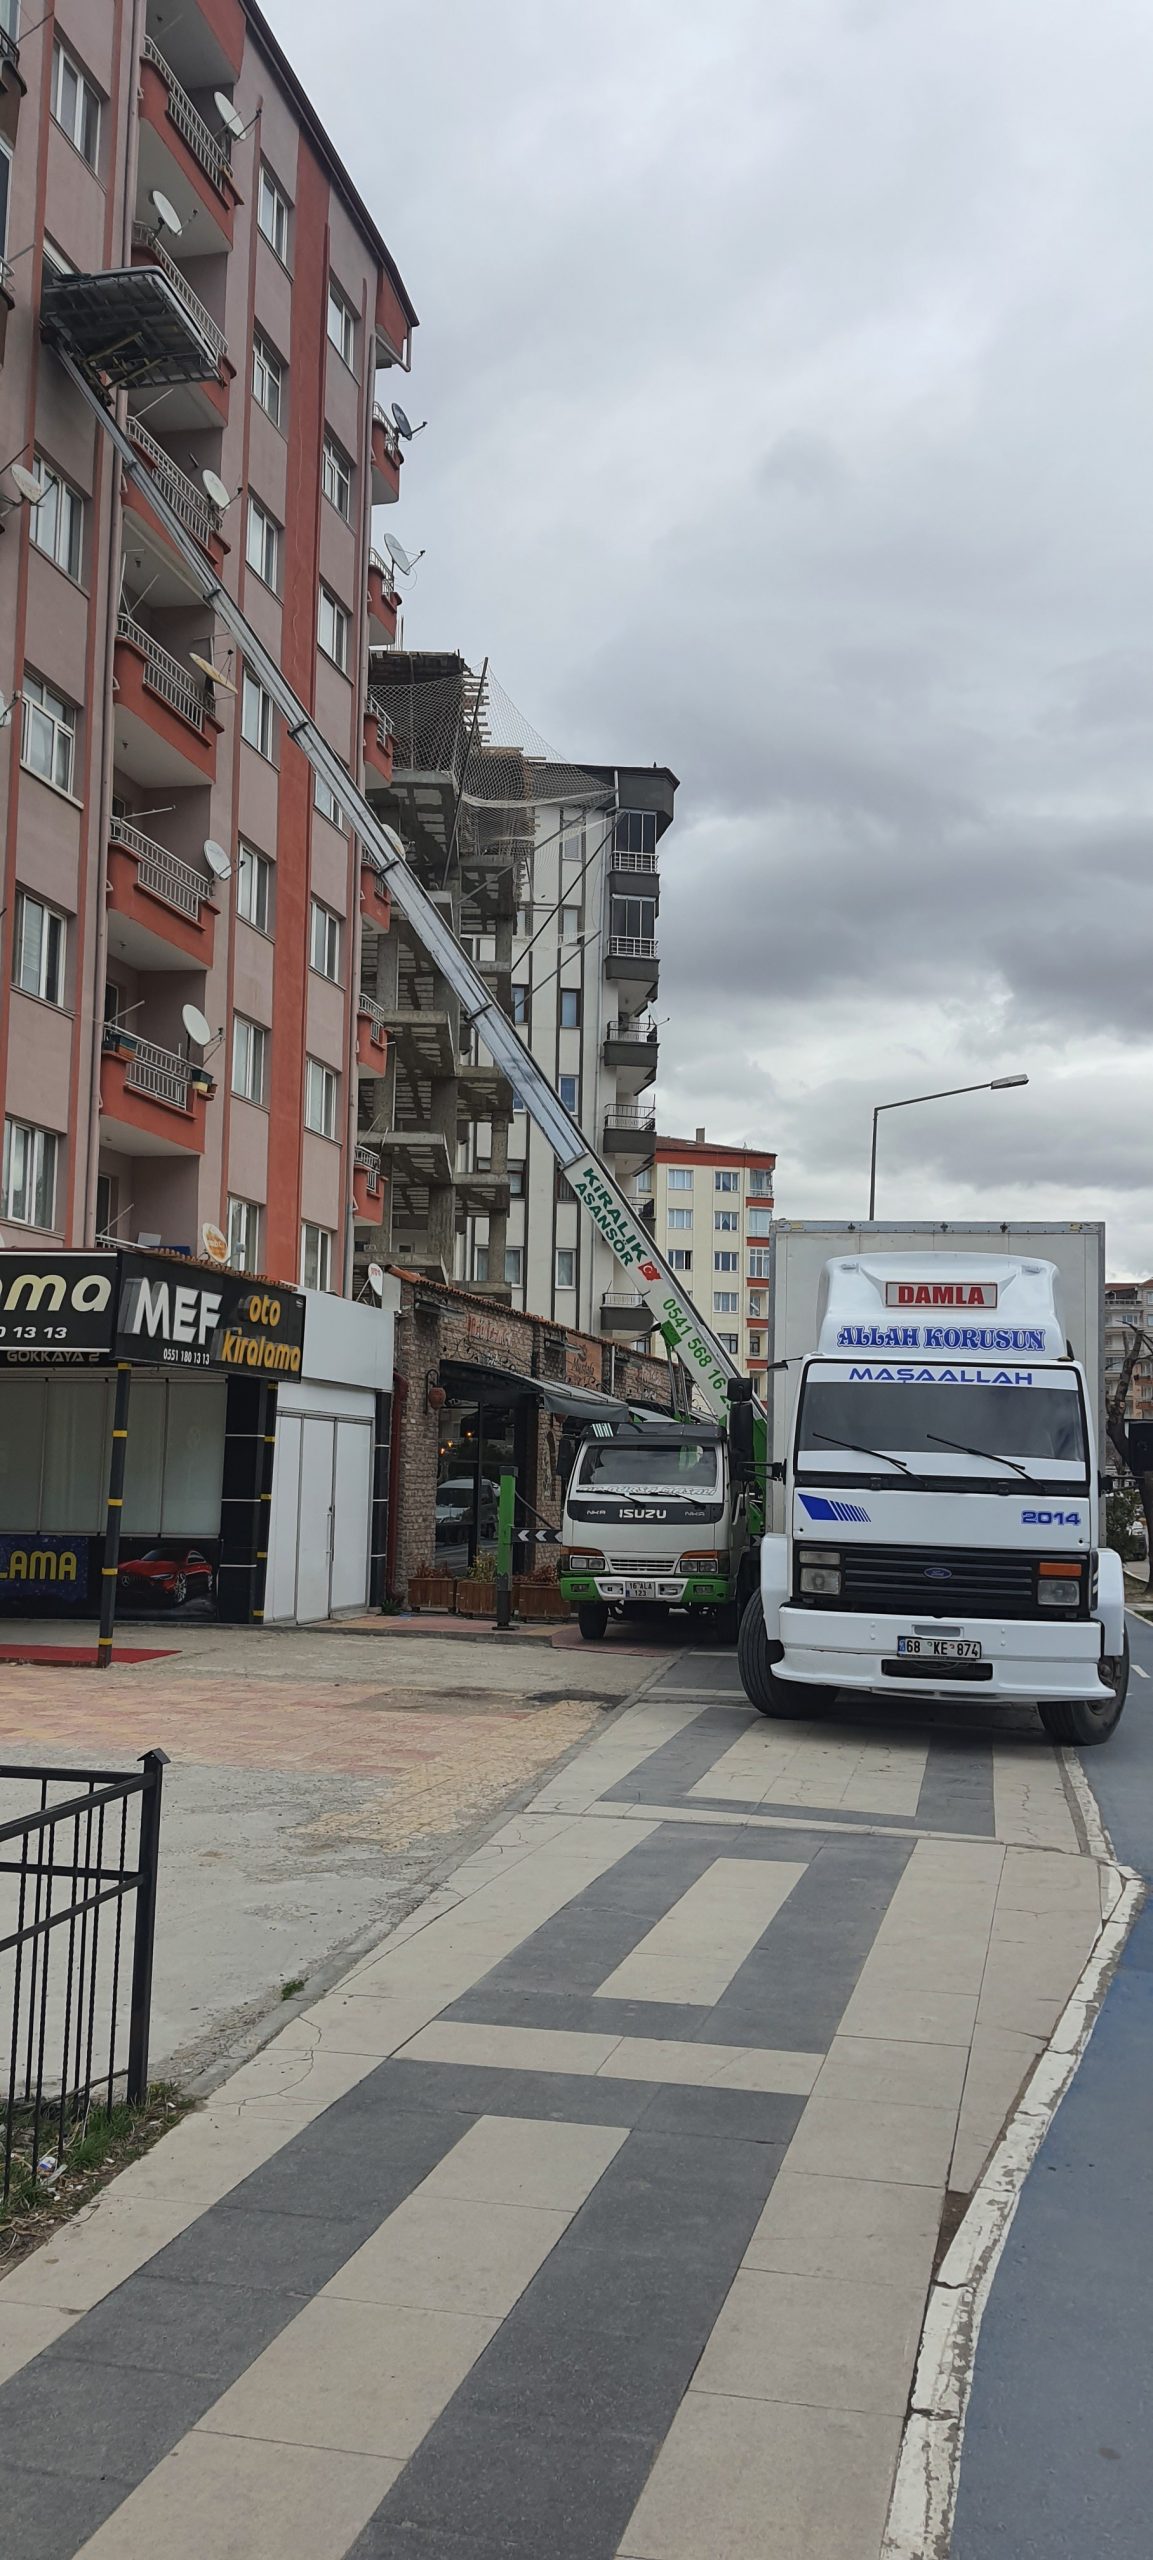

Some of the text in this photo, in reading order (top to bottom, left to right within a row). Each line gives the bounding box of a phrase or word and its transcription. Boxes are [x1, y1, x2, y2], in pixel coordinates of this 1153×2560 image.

[575, 1183, 634, 1267] ASANSÖR
[898, 1286, 985, 1305] DAMLA
[130, 1277, 223, 1345] MEF
[249, 1294, 281, 1327] oto
[13, 1326, 37, 1339] 13
[43, 1327, 68, 1339] 13
[837, 1325, 1045, 1351] ALLAH KORUSUN
[221, 1328, 301, 1372] kiralama
[662, 1299, 693, 1336] 0541
[688, 1336, 713, 1368] 568
[708, 1369, 726, 1390] 16
[163, 1348, 210, 1365] 0551 180 13 13
[849, 1367, 1033, 1386] MAŞAALLAH
[619, 1509, 667, 1519] ISUZU
[1020, 1510, 1082, 1526] 2014
[906, 1640, 921, 1654] 68
[933, 1641, 948, 1656] KE
[957, 1643, 979, 1657] 874
